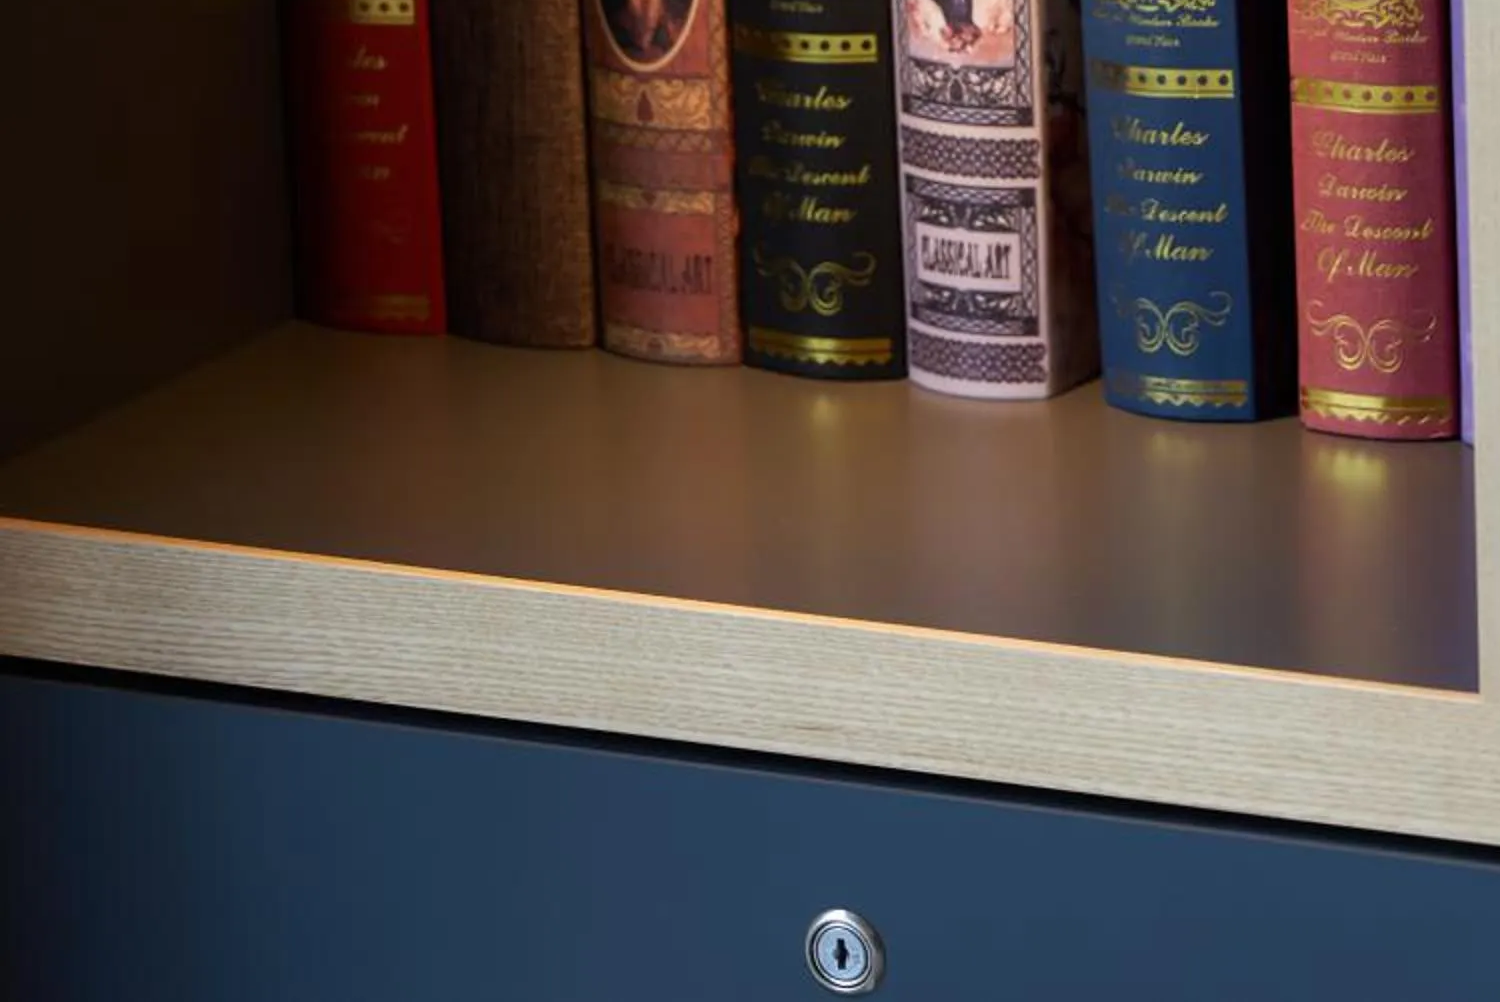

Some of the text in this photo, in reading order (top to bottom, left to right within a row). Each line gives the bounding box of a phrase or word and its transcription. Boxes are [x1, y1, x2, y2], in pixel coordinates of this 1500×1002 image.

[755, 81, 850, 110] arles
[1312, 129, 1416, 163] Charles
[1318, 172, 1408, 202] Darwin
[1301, 208, 1434, 241] The Descent
[1347, 249, 1419, 278] Man
